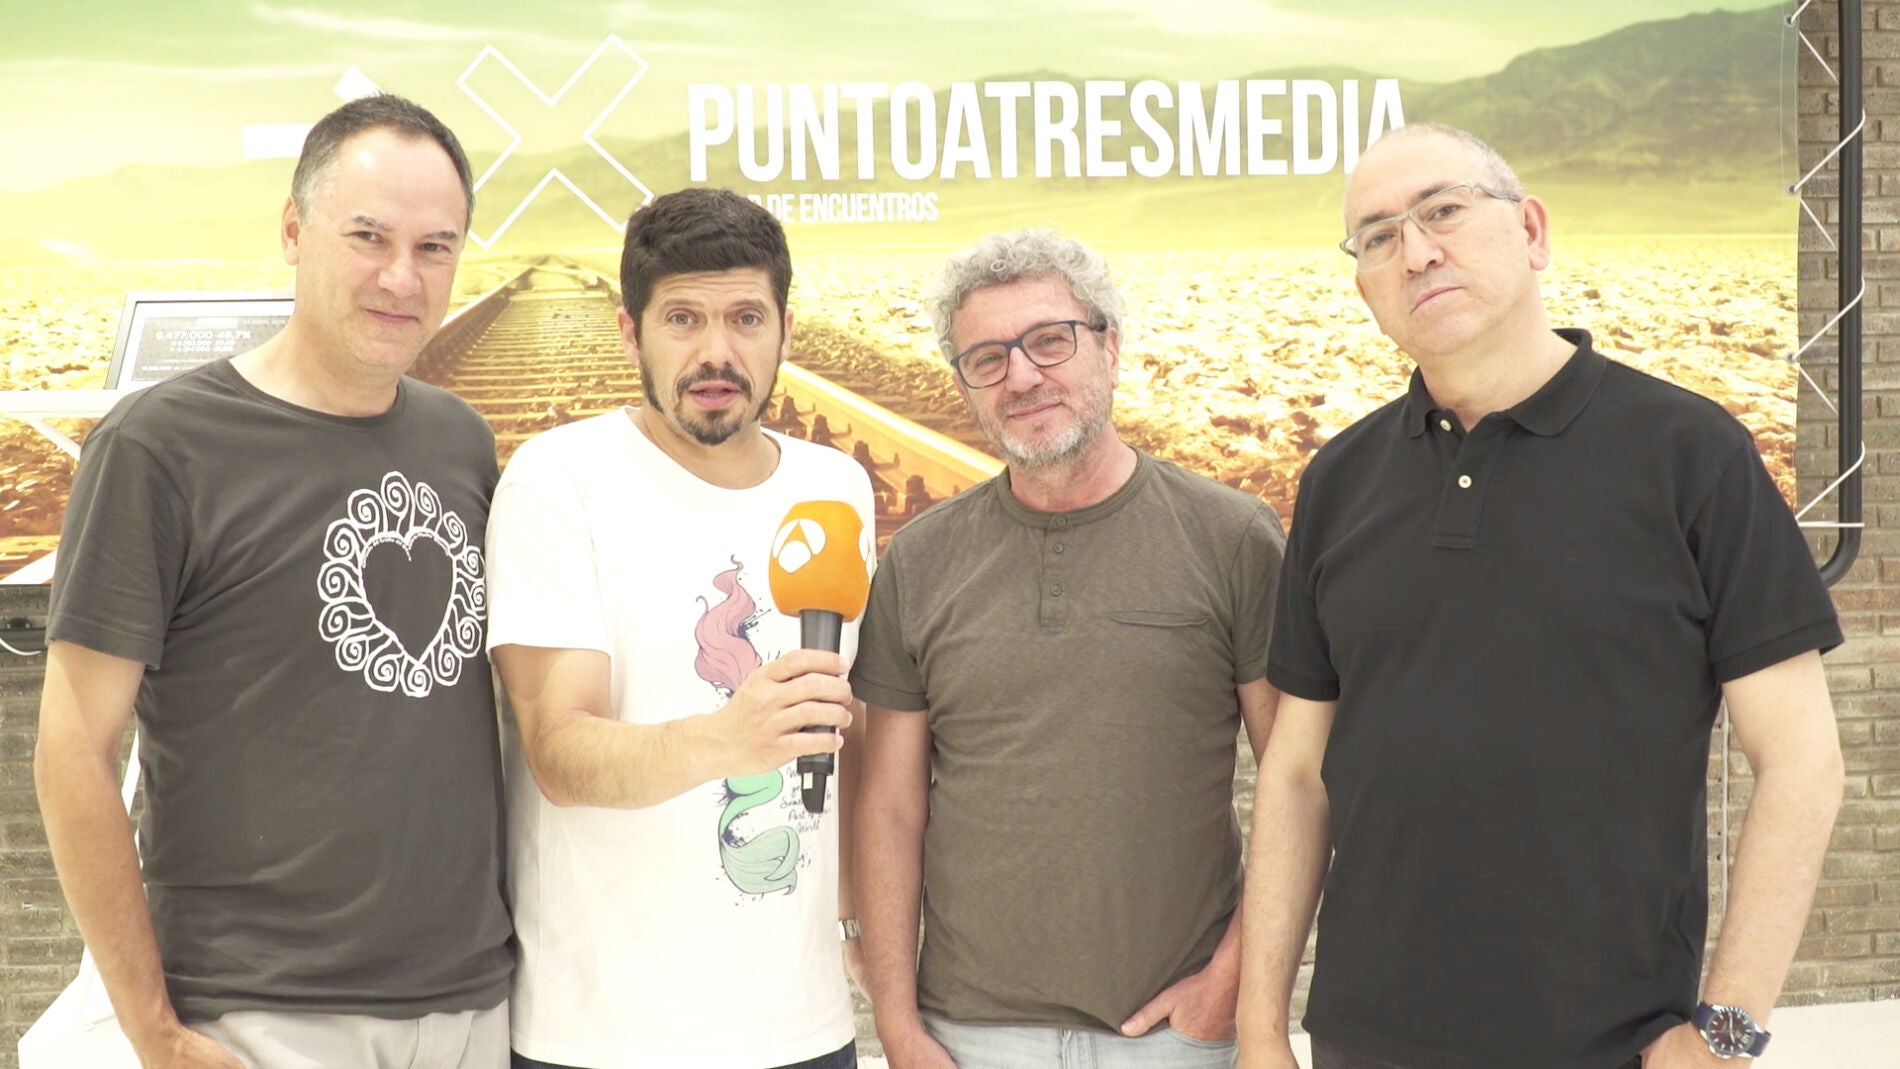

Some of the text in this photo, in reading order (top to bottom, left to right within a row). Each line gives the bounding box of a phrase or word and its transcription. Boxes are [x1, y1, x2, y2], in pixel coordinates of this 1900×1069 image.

[687, 78, 1406, 182] PUNTOATRESMEDIA
[770, 194, 795, 223] DE
[800, 192, 939, 224] ENCUENTROS
